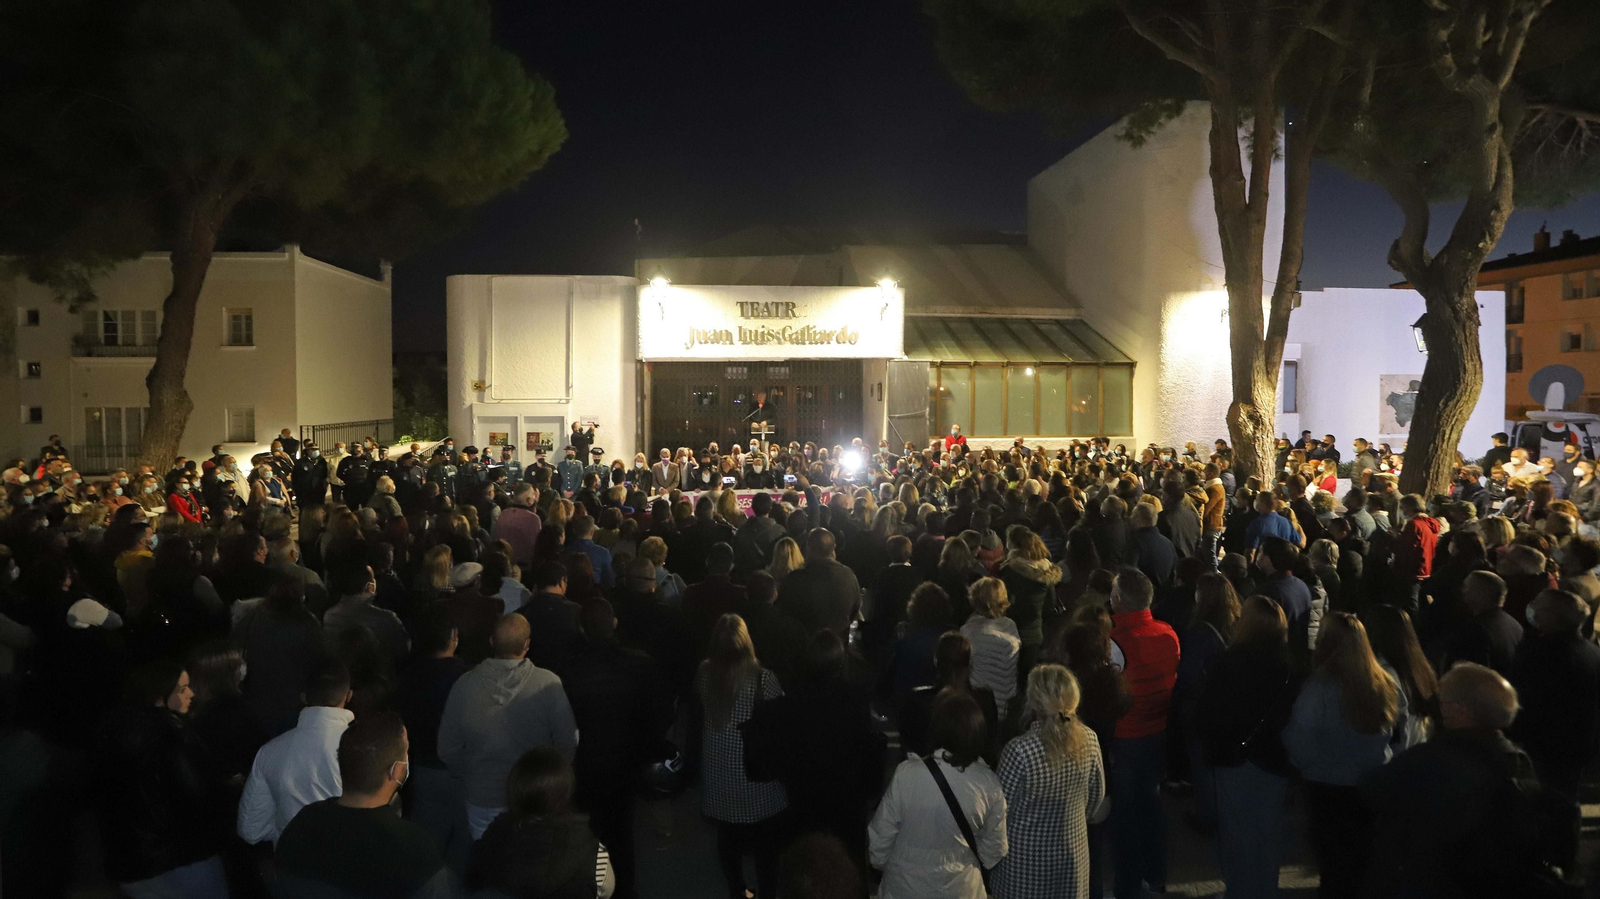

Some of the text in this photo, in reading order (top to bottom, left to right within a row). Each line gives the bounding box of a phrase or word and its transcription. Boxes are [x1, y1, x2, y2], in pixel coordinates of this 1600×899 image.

[736, 301, 799, 318] TEATR
[684, 327, 733, 350] Juan
[738, 325, 776, 345] Luis
